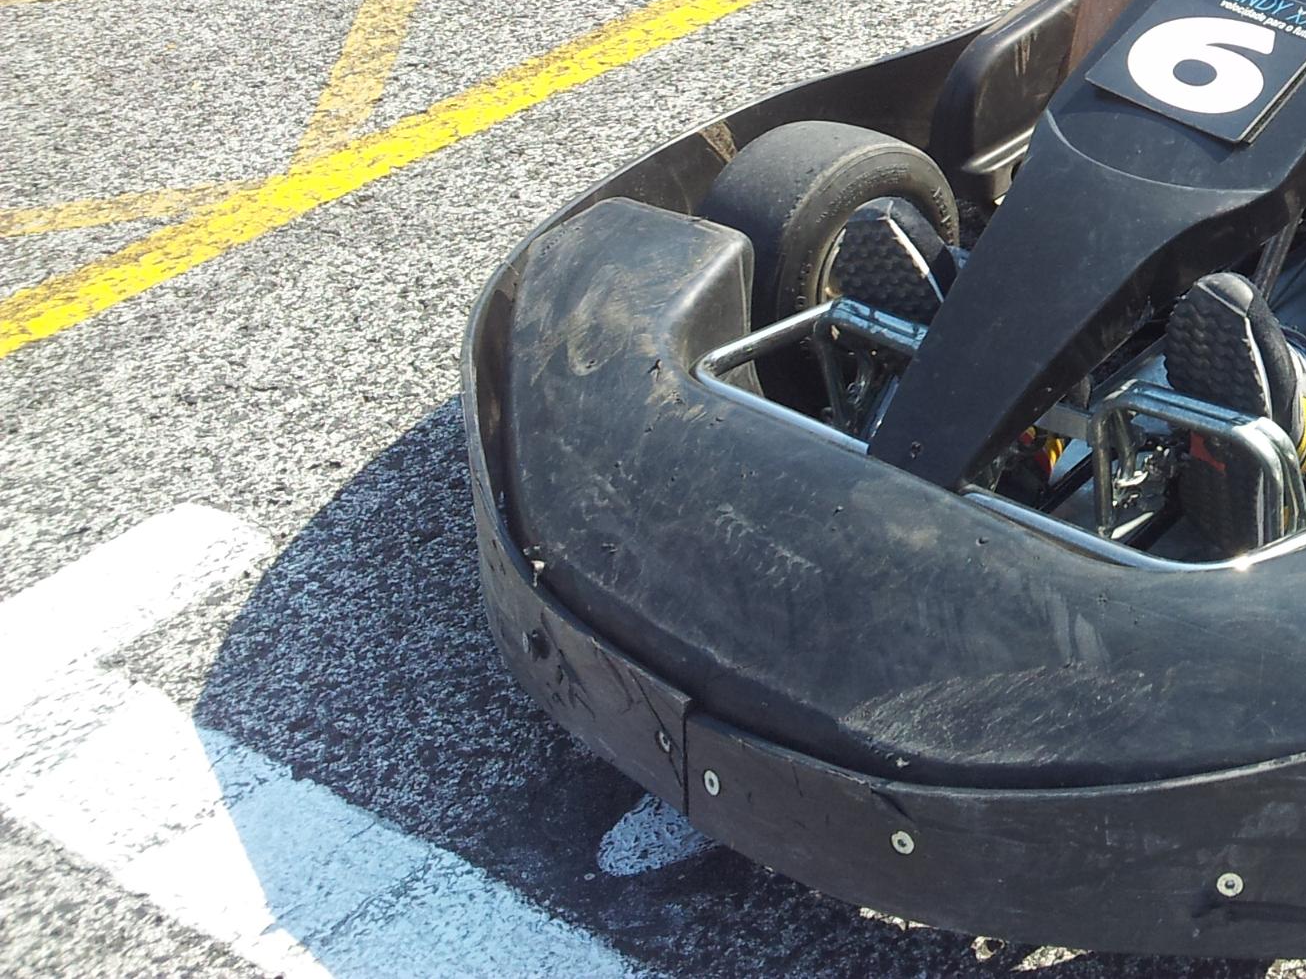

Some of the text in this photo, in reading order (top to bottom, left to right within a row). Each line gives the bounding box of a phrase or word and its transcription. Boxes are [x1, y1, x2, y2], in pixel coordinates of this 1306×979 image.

[1220, 0, 1267, 22] velocidade
[1263, 17, 1287, 30] para
[1285, 24, 1294, 32] o
[1127, 16, 1277, 115] 6
